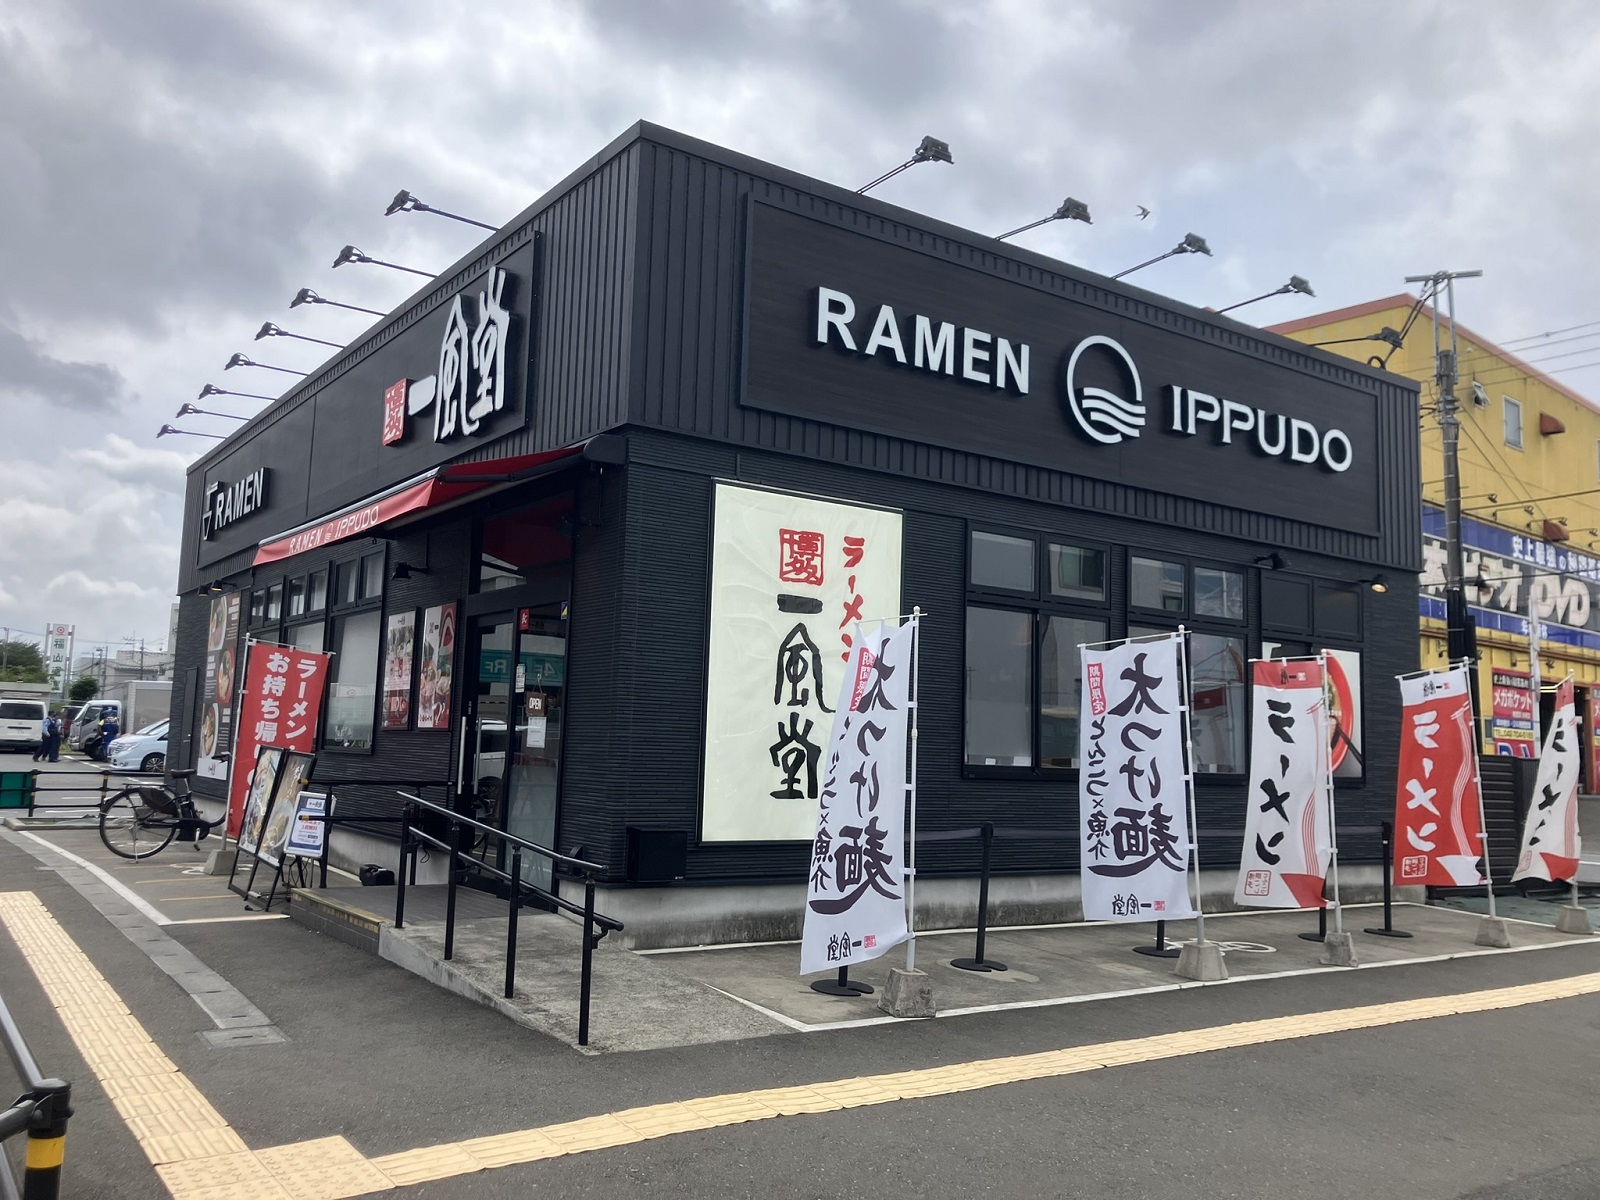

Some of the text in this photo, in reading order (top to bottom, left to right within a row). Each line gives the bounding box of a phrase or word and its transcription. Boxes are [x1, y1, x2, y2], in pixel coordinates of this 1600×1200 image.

[408, 264, 510, 443] 一風堂
[817, 286, 1354, 474] RAMEN IPPUDO
[214, 467, 264, 531] RAMEN
[288, 504, 380, 556] RAMEN IPPUDO
[1530, 569, 1590, 628] DVD
[529, 697, 542, 710] OPEN
[769, 593, 838, 801] 一風堂
